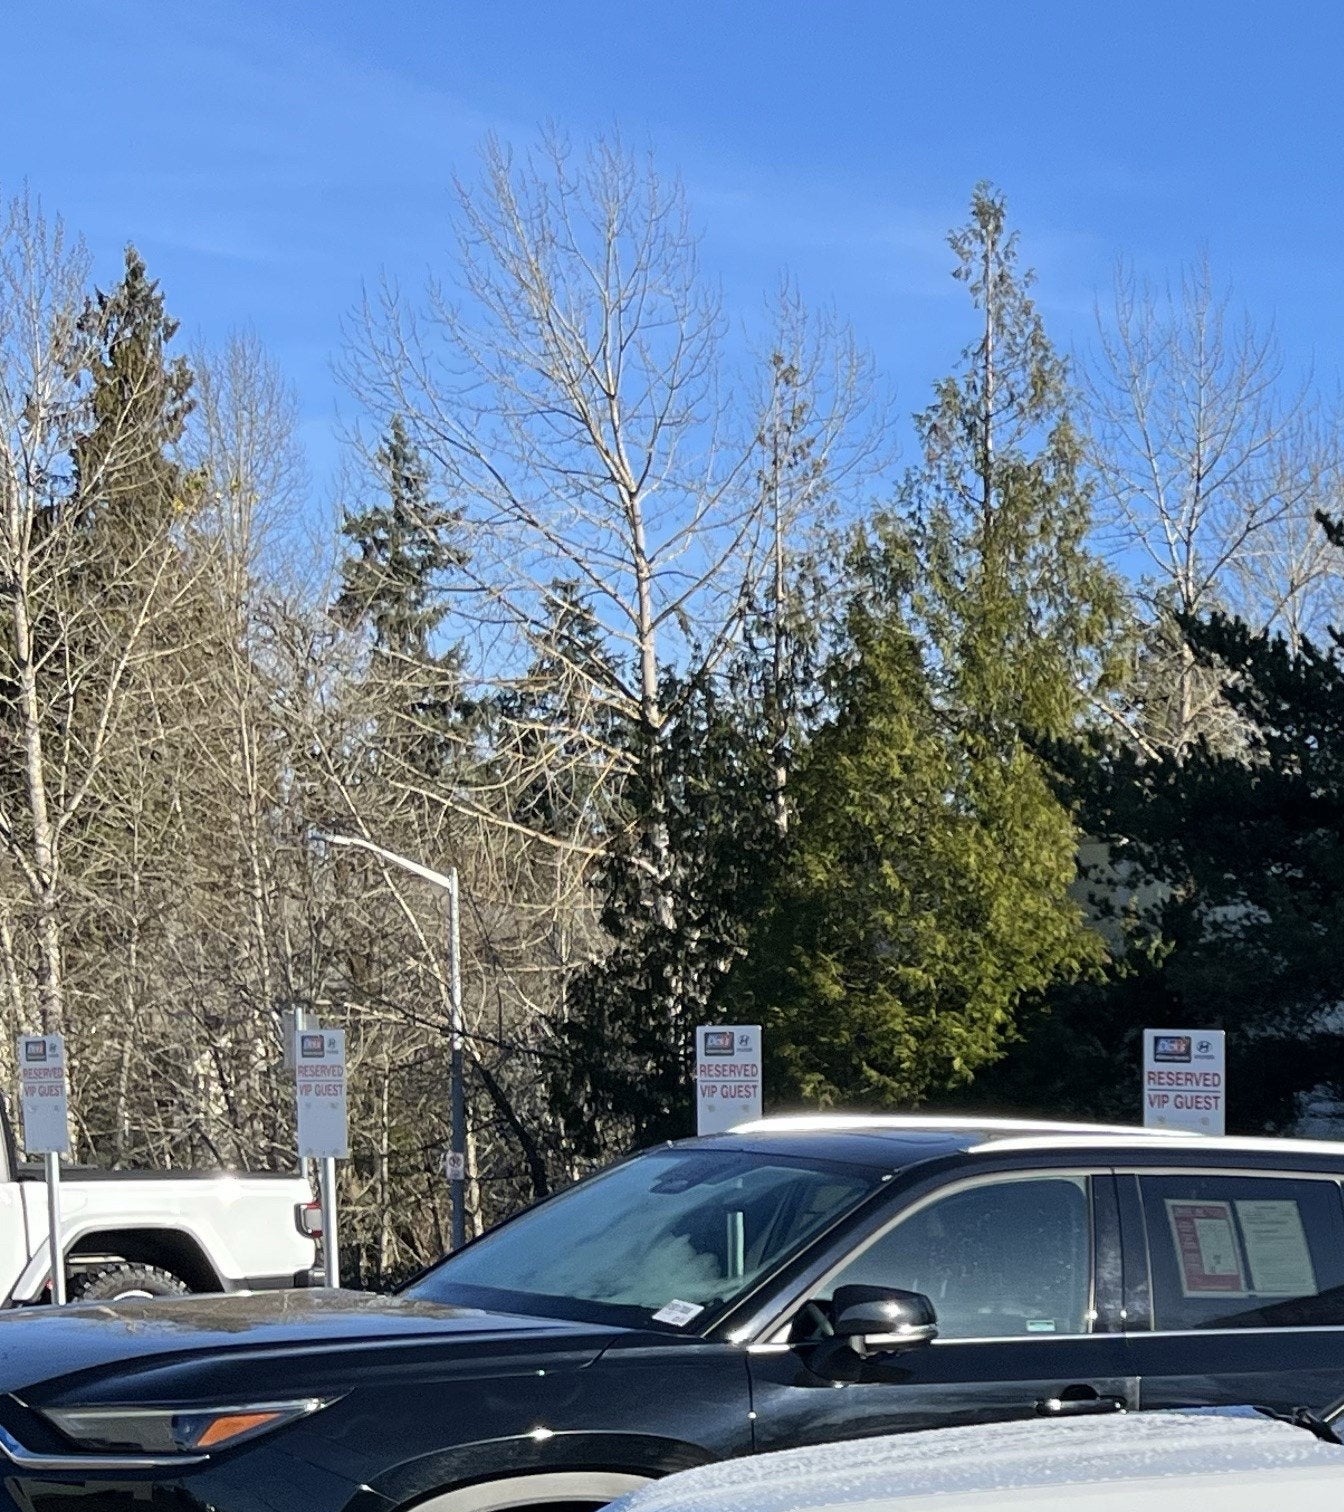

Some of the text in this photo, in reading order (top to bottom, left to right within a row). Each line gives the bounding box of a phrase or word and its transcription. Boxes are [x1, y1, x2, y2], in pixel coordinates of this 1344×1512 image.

[23, 1067, 64, 1079] RESERVED
[297, 1065, 344, 1078] RESERVED
[699, 1063, 759, 1078] RESERVED
[1147, 1071, 1222, 1087] RESERVED
[314, 1083, 343, 1097] GUEST
[700, 1084, 759, 1099] VIP GUEST
[1148, 1094, 1221, 1111] VIP GUEST
